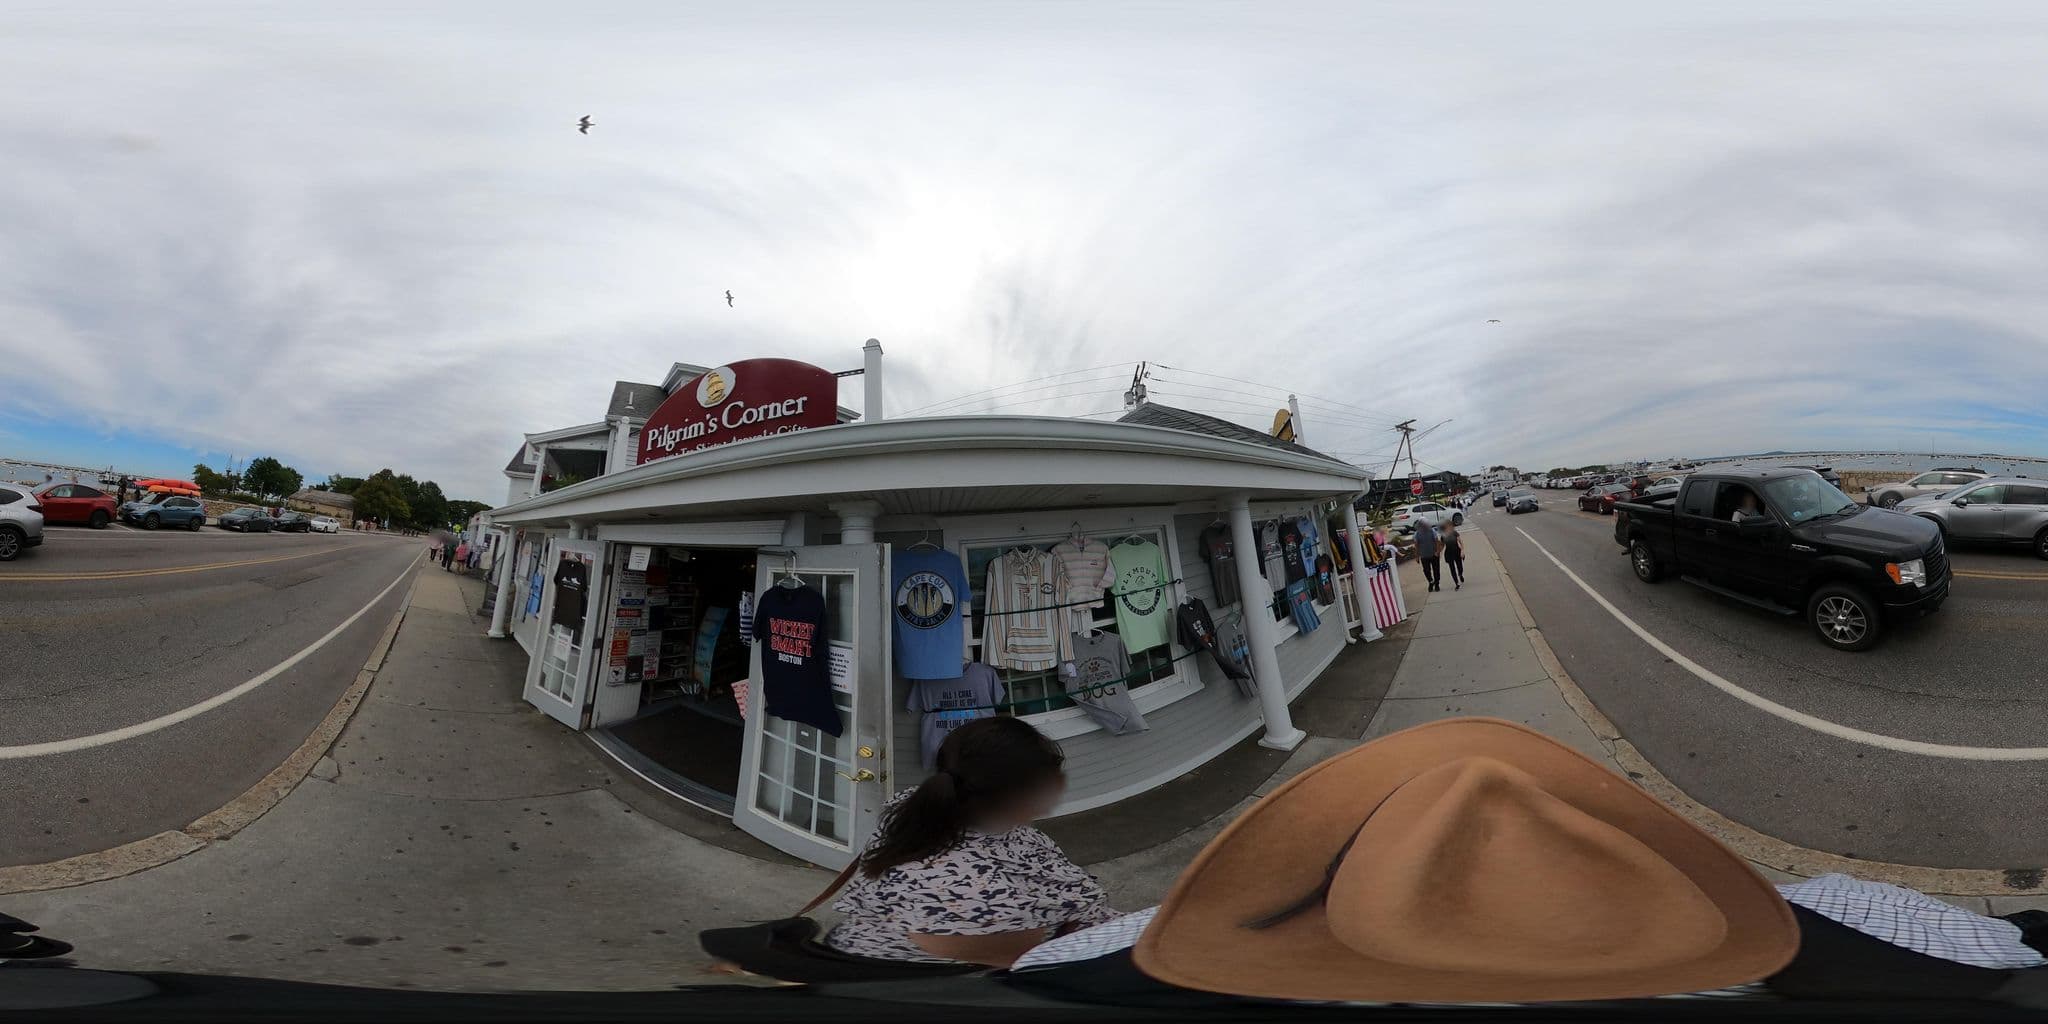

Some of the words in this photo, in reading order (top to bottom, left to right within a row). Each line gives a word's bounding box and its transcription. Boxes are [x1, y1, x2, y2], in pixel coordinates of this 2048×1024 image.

[647, 413, 718, 452] Pilgrim's
[722, 396, 808, 429] Corner
[903, 574, 927, 590] CAPE
[1121, 566, 1159, 591] PLYMOUTH
[778, 653, 803, 666] BOSTON
[1079, 682, 1116, 702] DOG
